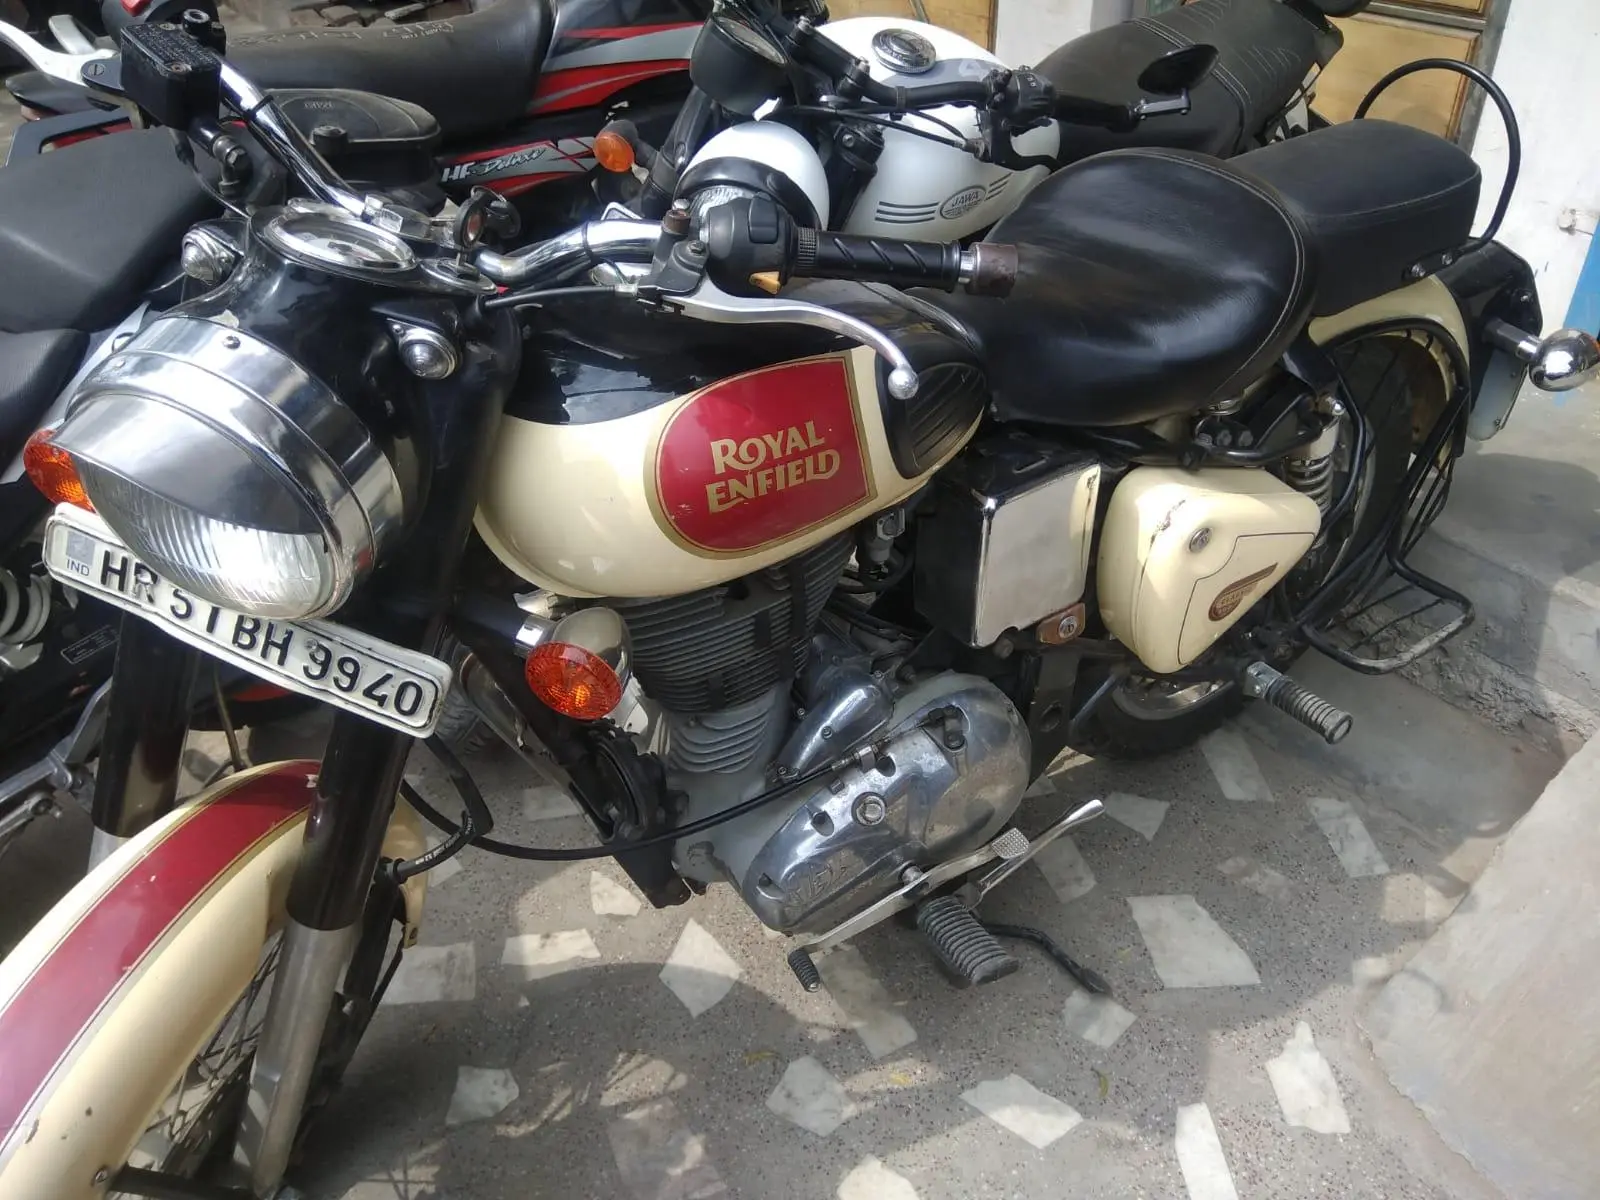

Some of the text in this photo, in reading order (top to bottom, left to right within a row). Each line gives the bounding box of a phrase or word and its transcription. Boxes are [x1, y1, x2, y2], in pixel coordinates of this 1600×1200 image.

[441, 162, 475, 182] HF
[952, 191, 979, 208] JAWA
[710, 420, 826, 475] ROYAL
[704, 448, 841, 515] ENFIELD
[66, 557, 90, 577] IND
[100, 550, 159, 605] HR
[232, 614, 294, 667] BH
[302, 637, 423, 717] 9940
